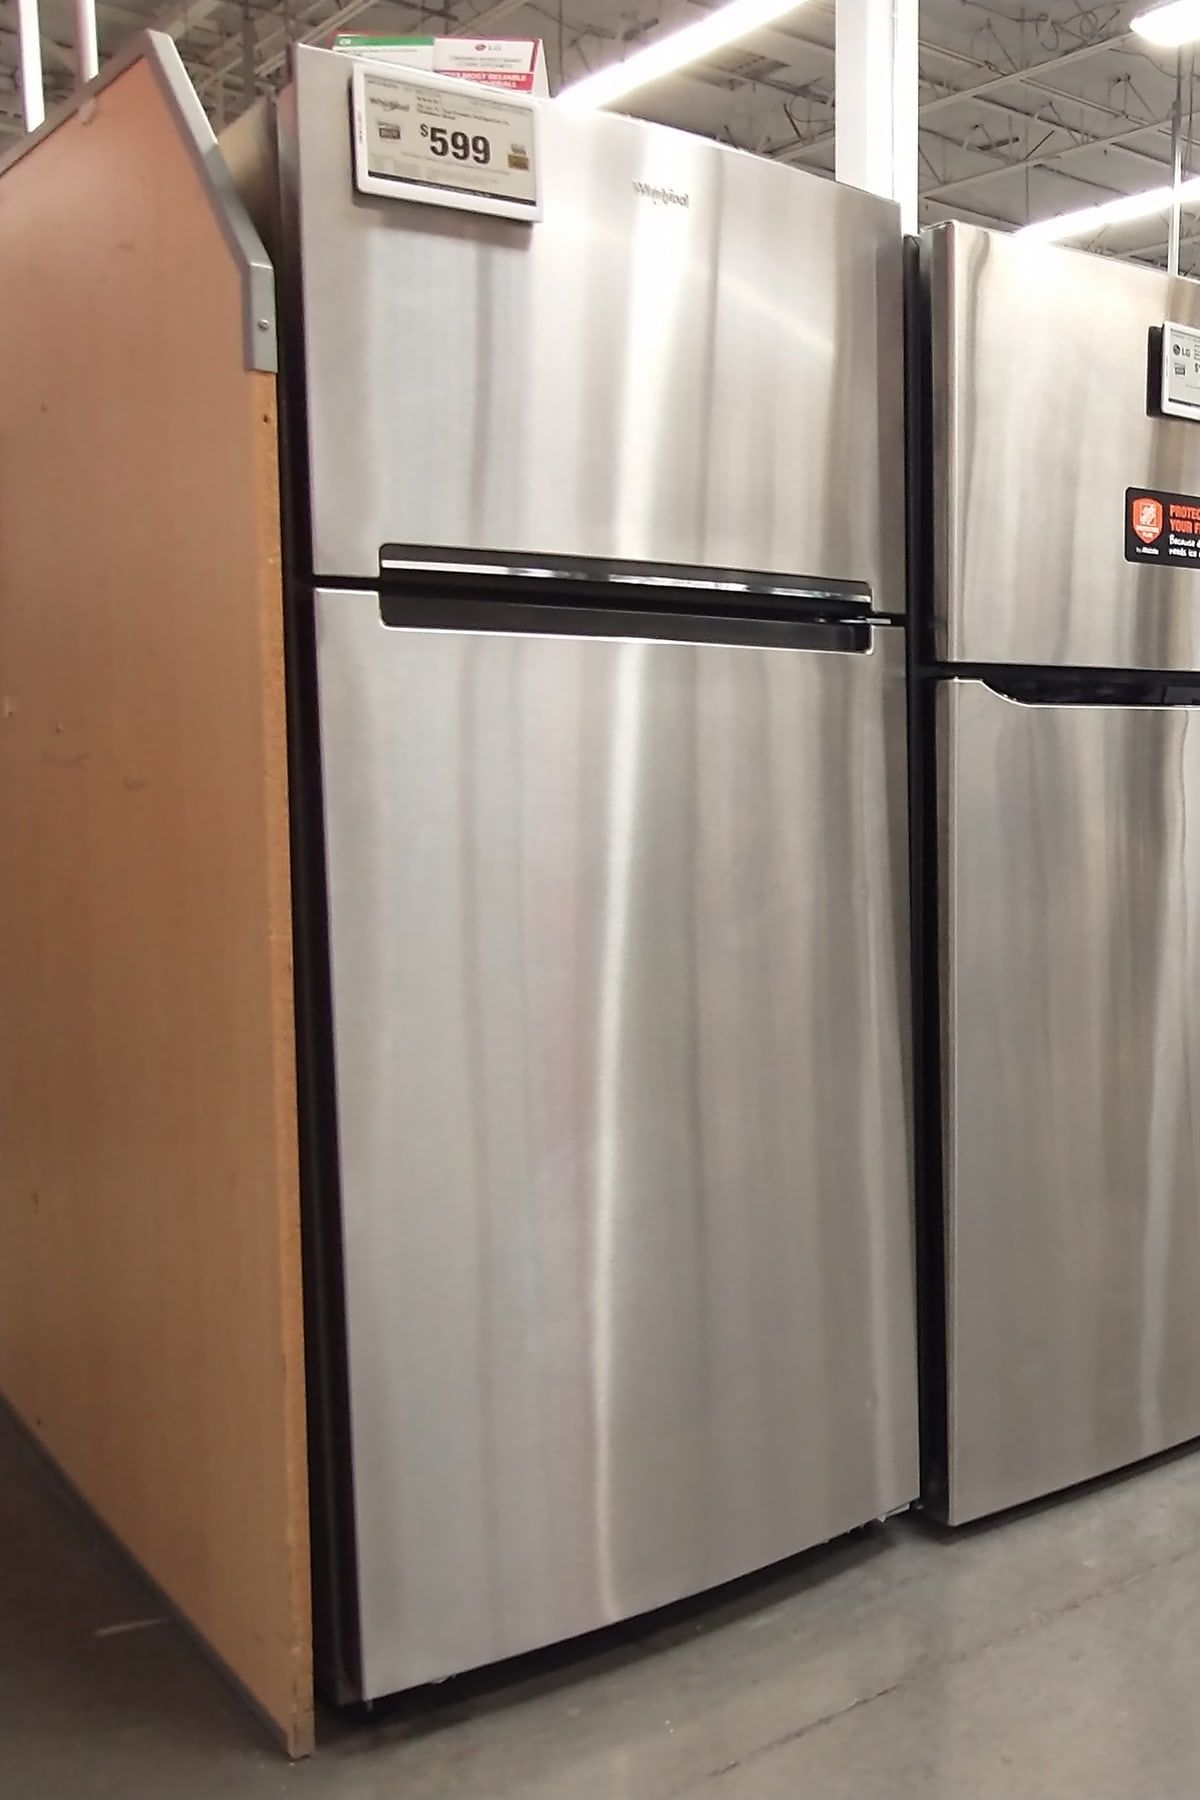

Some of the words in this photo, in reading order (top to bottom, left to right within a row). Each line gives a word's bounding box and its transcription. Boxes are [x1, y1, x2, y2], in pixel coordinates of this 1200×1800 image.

[420, 123, 491, 165] $599
[1169, 518, 1193, 534] YOUR
[1169, 533, 1196, 548] Because
